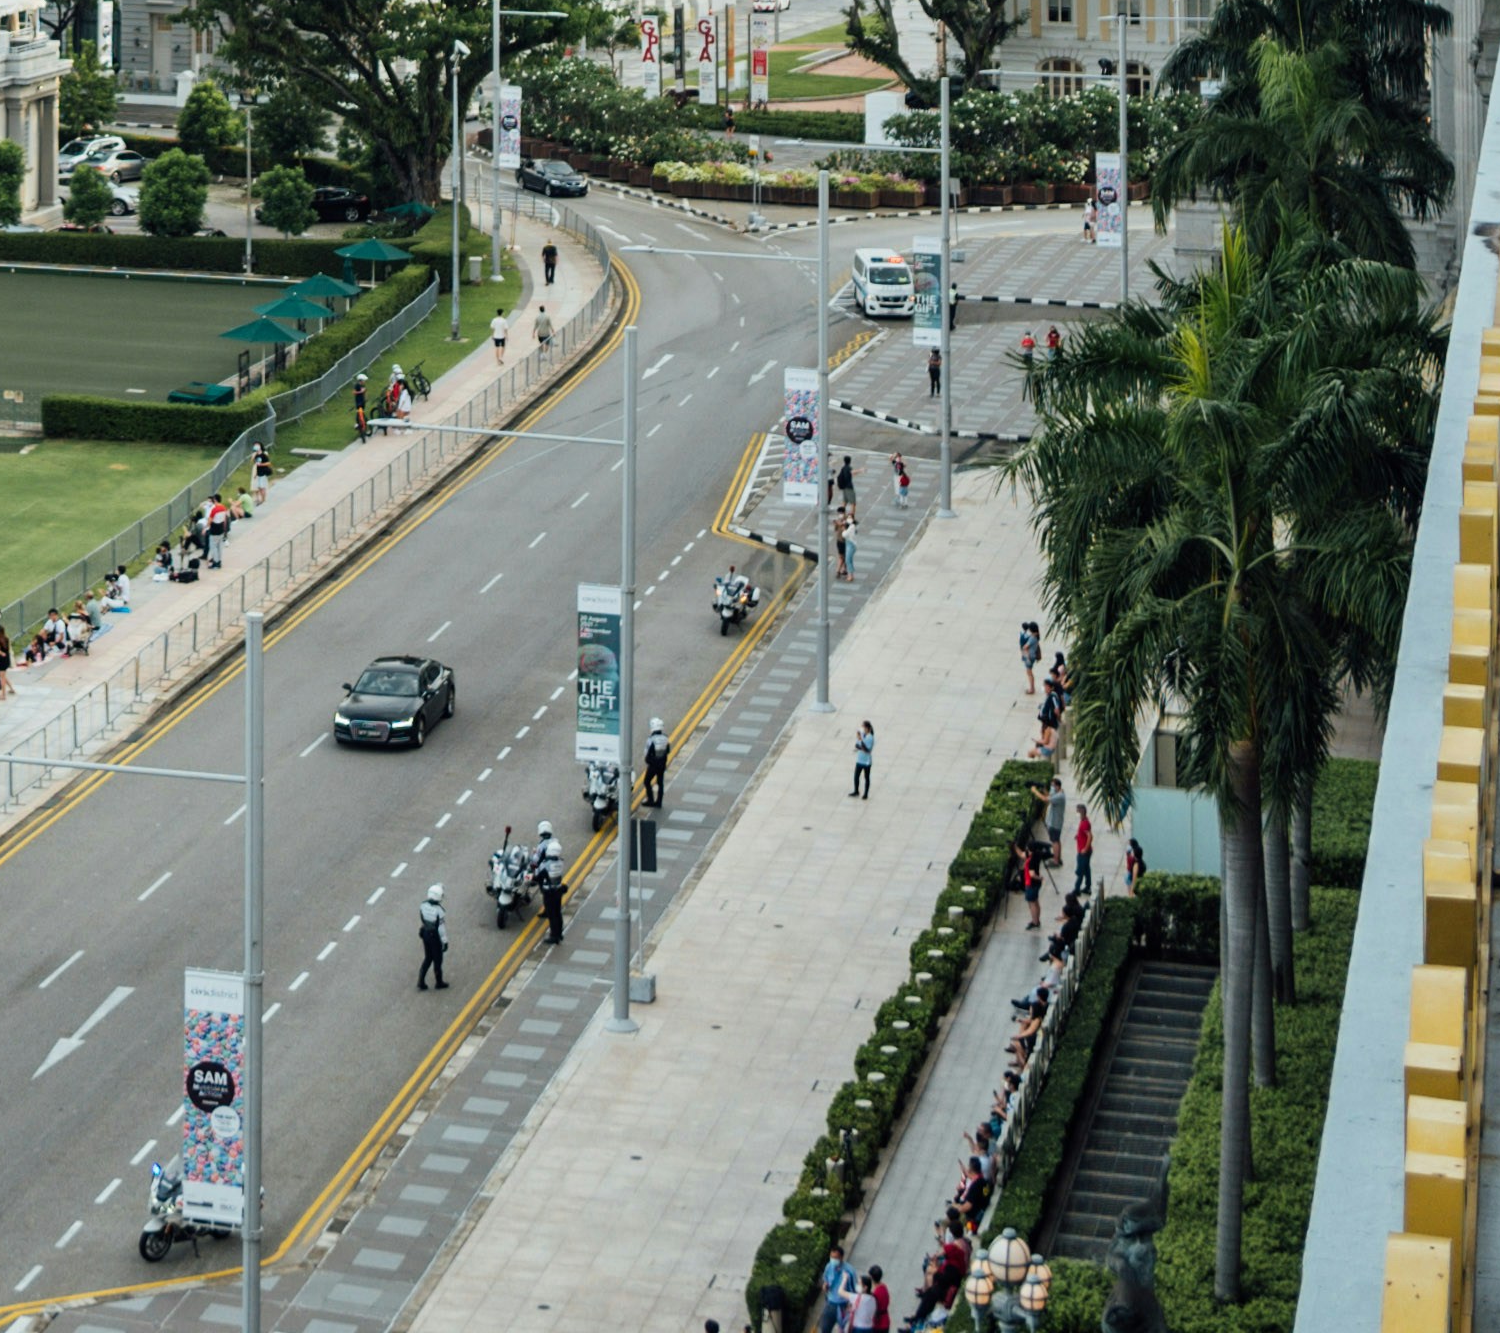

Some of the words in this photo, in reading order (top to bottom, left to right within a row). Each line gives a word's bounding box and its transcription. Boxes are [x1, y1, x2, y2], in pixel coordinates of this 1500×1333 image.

[641, 20, 658, 62] GPA
[698, 20, 714, 62] GPA
[915, 294, 937, 304] THE
[914, 304, 938, 313] GIFT
[790, 420, 810, 429] SAM
[579, 678, 613, 695] THE
[579, 694, 616, 710] GIFT
[194, 1069, 227, 1085] SAM
